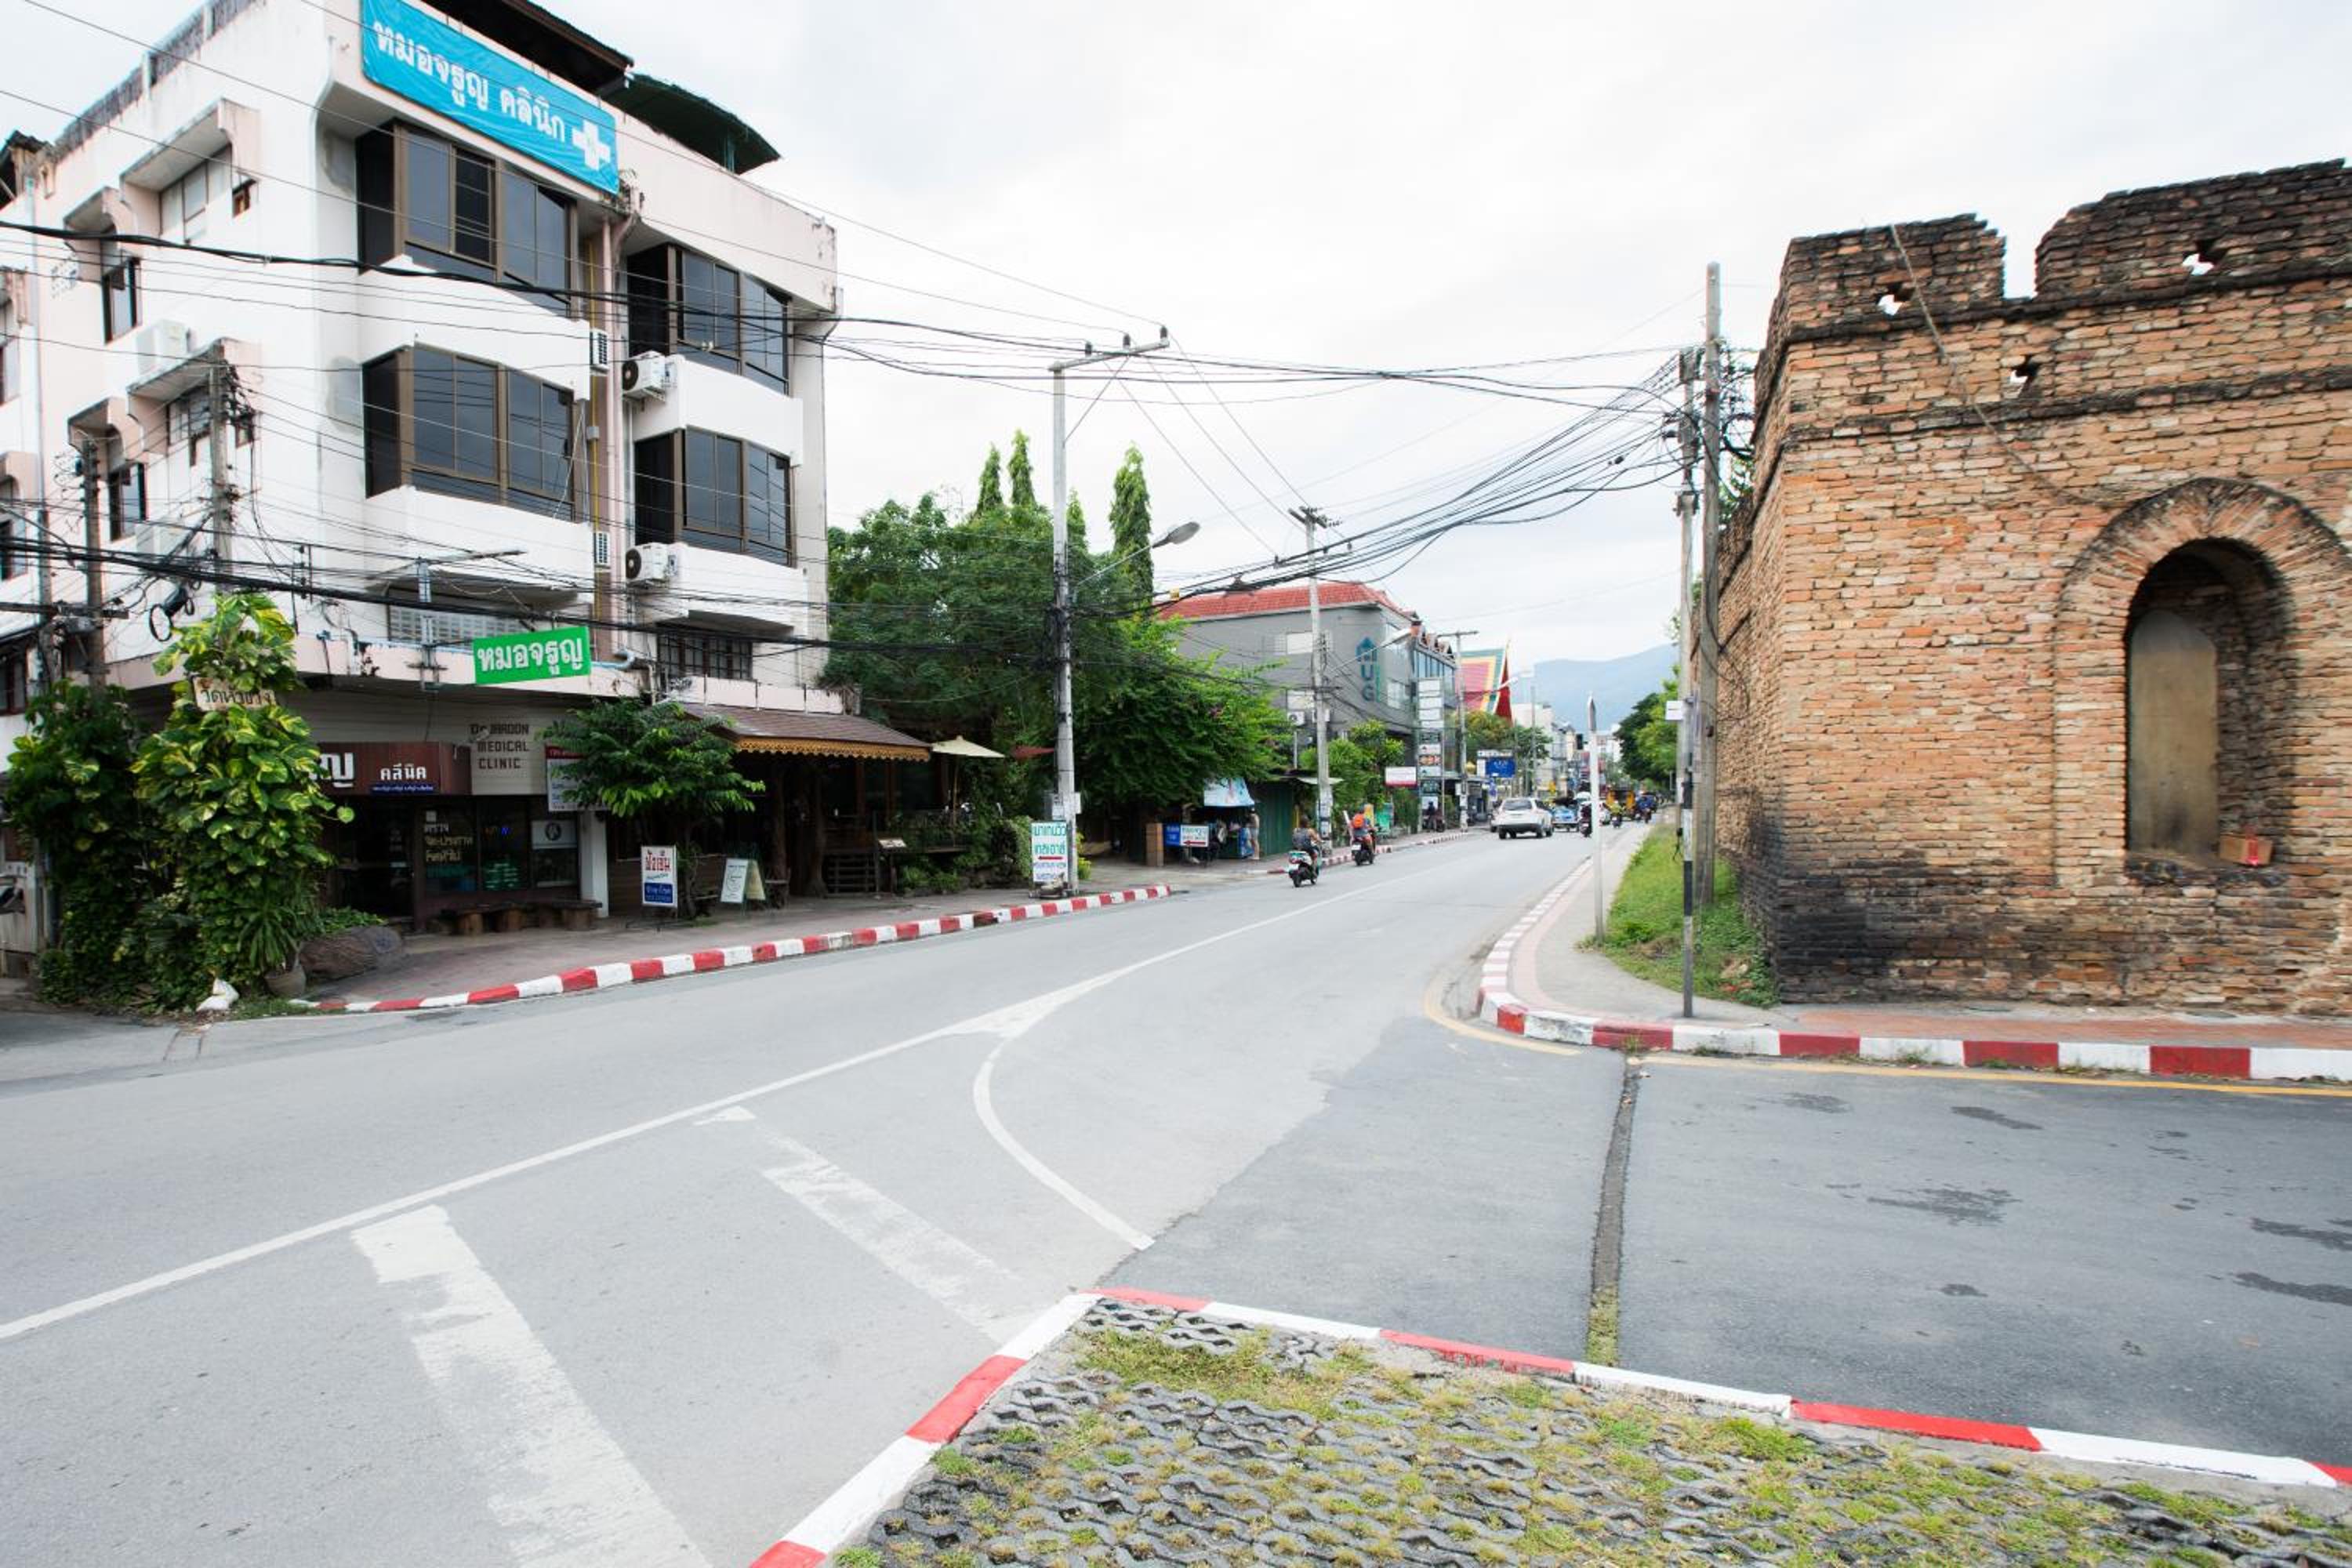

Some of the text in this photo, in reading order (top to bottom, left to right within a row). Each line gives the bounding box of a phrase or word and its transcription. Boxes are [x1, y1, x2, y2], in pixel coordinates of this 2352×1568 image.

[372, 20, 565, 143] หมอจรูญ คลินิก
[477, 637, 583, 675] หมอจรูญ
[477, 740, 530, 753] MEDICAL
[479, 757, 521, 769] CLINIC
